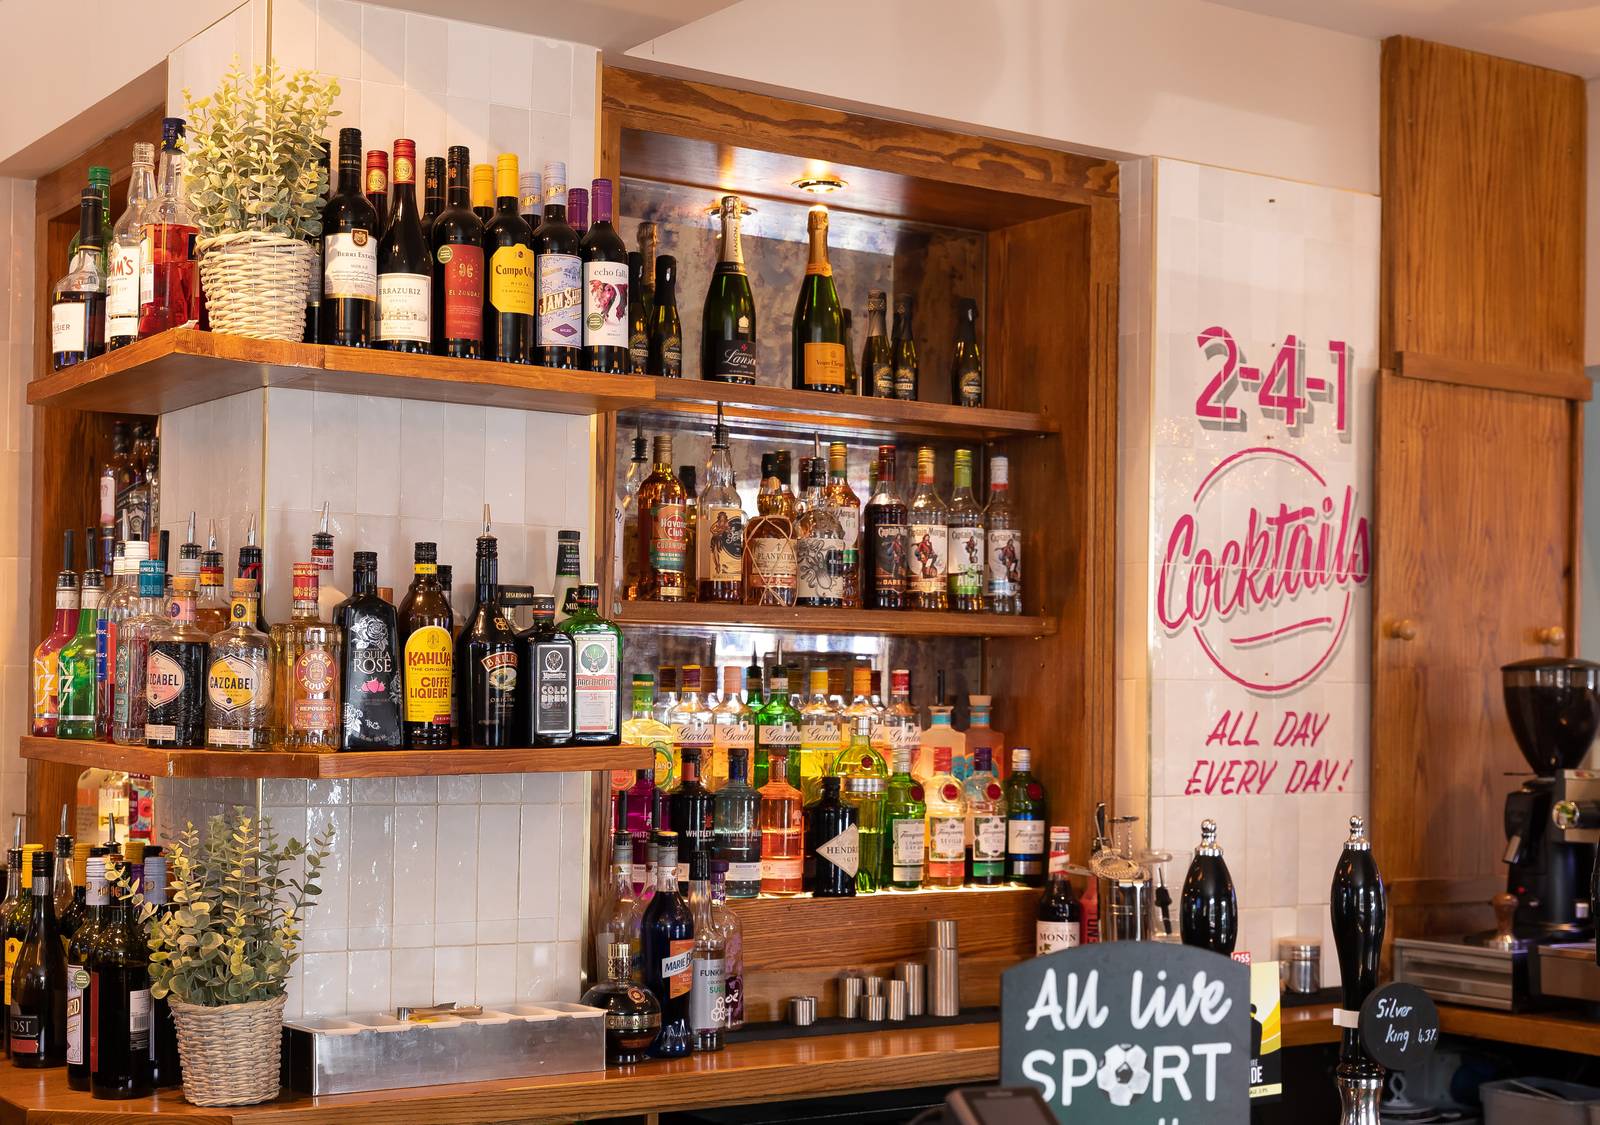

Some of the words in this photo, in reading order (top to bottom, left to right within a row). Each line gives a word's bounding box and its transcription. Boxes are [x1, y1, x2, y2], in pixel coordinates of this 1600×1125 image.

[594, 268, 614, 277] echo
[1196, 326, 1349, 436] 2-4-1
[1158, 485, 1369, 631] Cocktails
[301, 653, 332, 668] OLMECA
[352, 650, 391, 660] TEQUILA
[353, 658, 392, 675] ROSE
[301, 676, 334, 691] TEQUILA
[541, 685, 568, 695] COLD
[410, 687, 448, 698] LIQUEUR
[1205, 710, 1260, 747] ALL
[1273, 711, 1330, 747] DAY
[1184, 760, 1278, 796] EVERY
[1285, 759, 1353, 794] DAY!
[1039, 932, 1077, 942] MONIN
[664, 957, 685, 973] MARIE
[1025, 967, 1109, 1031] All
[1130, 969, 1233, 1031] live
[1021, 1041, 1232, 1107] SPORT
